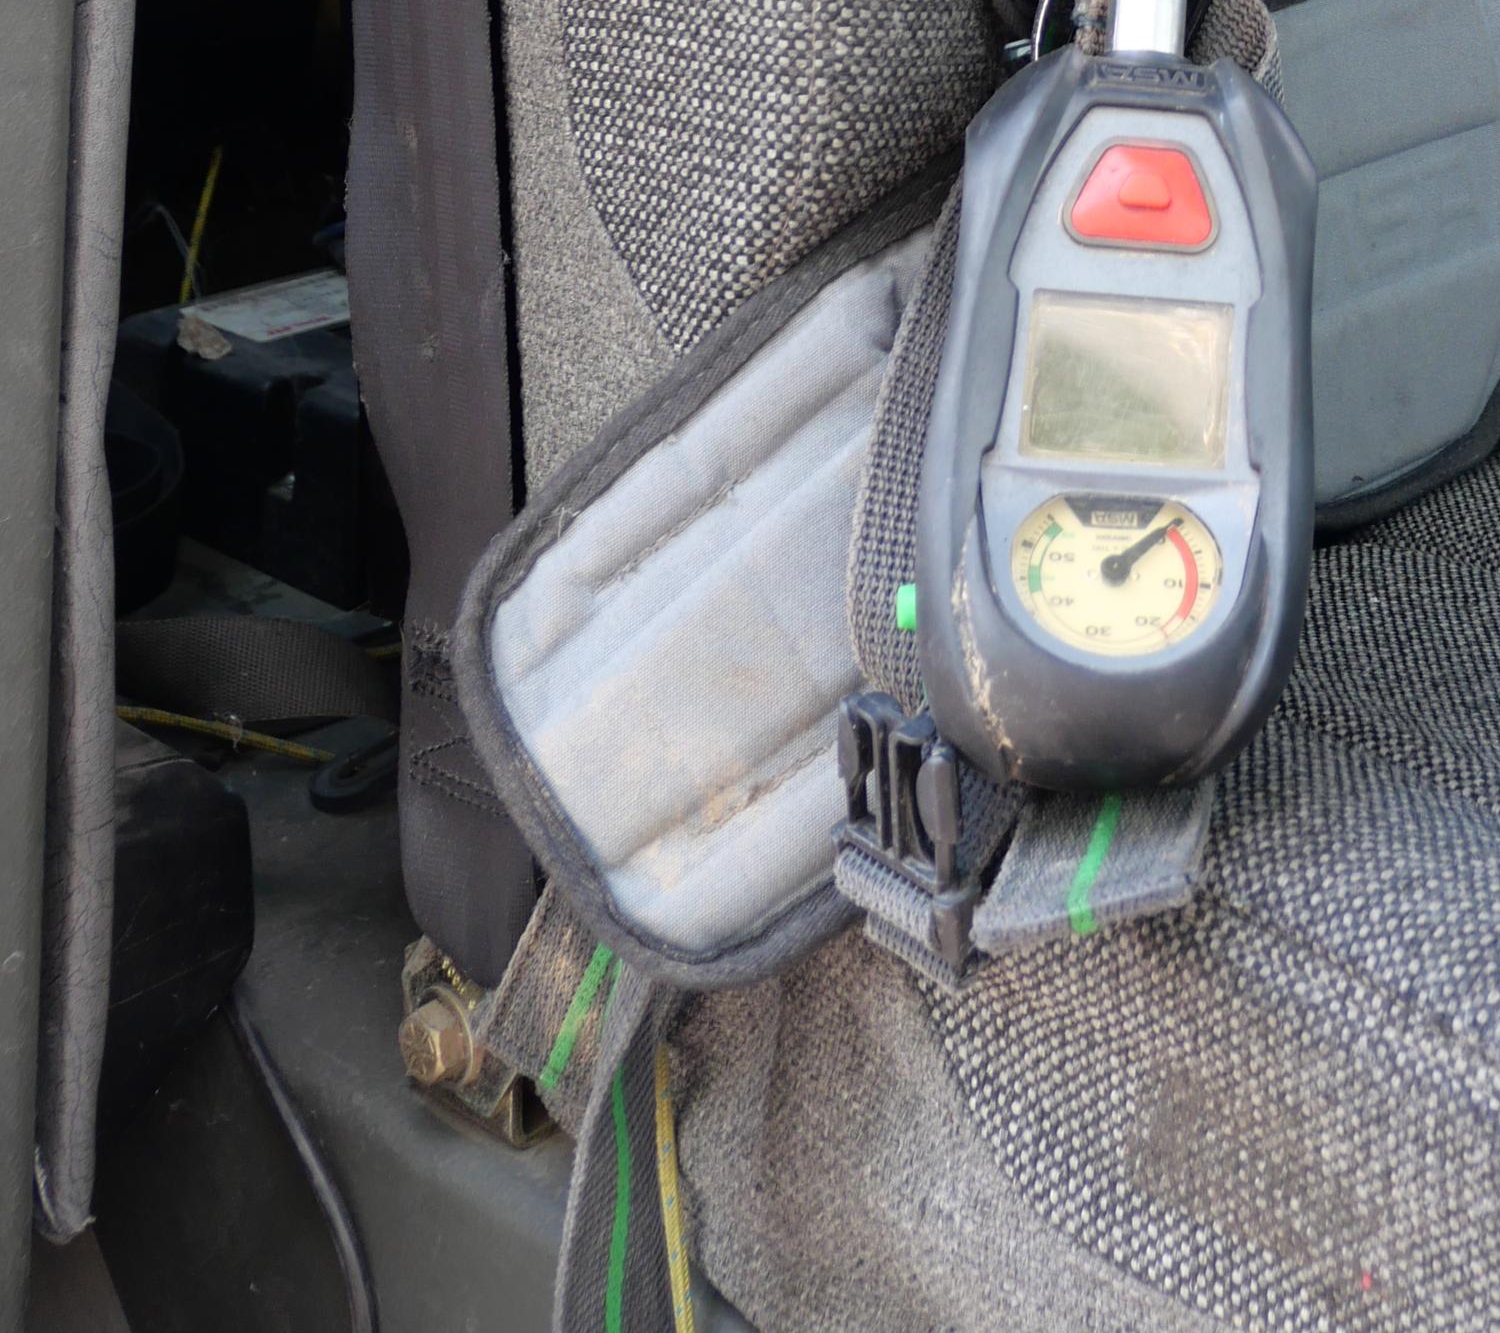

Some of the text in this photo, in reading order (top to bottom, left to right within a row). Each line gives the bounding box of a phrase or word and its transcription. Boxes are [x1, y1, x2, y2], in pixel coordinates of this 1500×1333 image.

[1093, 513, 1137, 526] MSA
[1050, 552, 1075, 562] 50
[1164, 578, 1183, 588] 10
[1135, 616, 1161, 626] 20
[1086, 626, 1112, 636] 30
